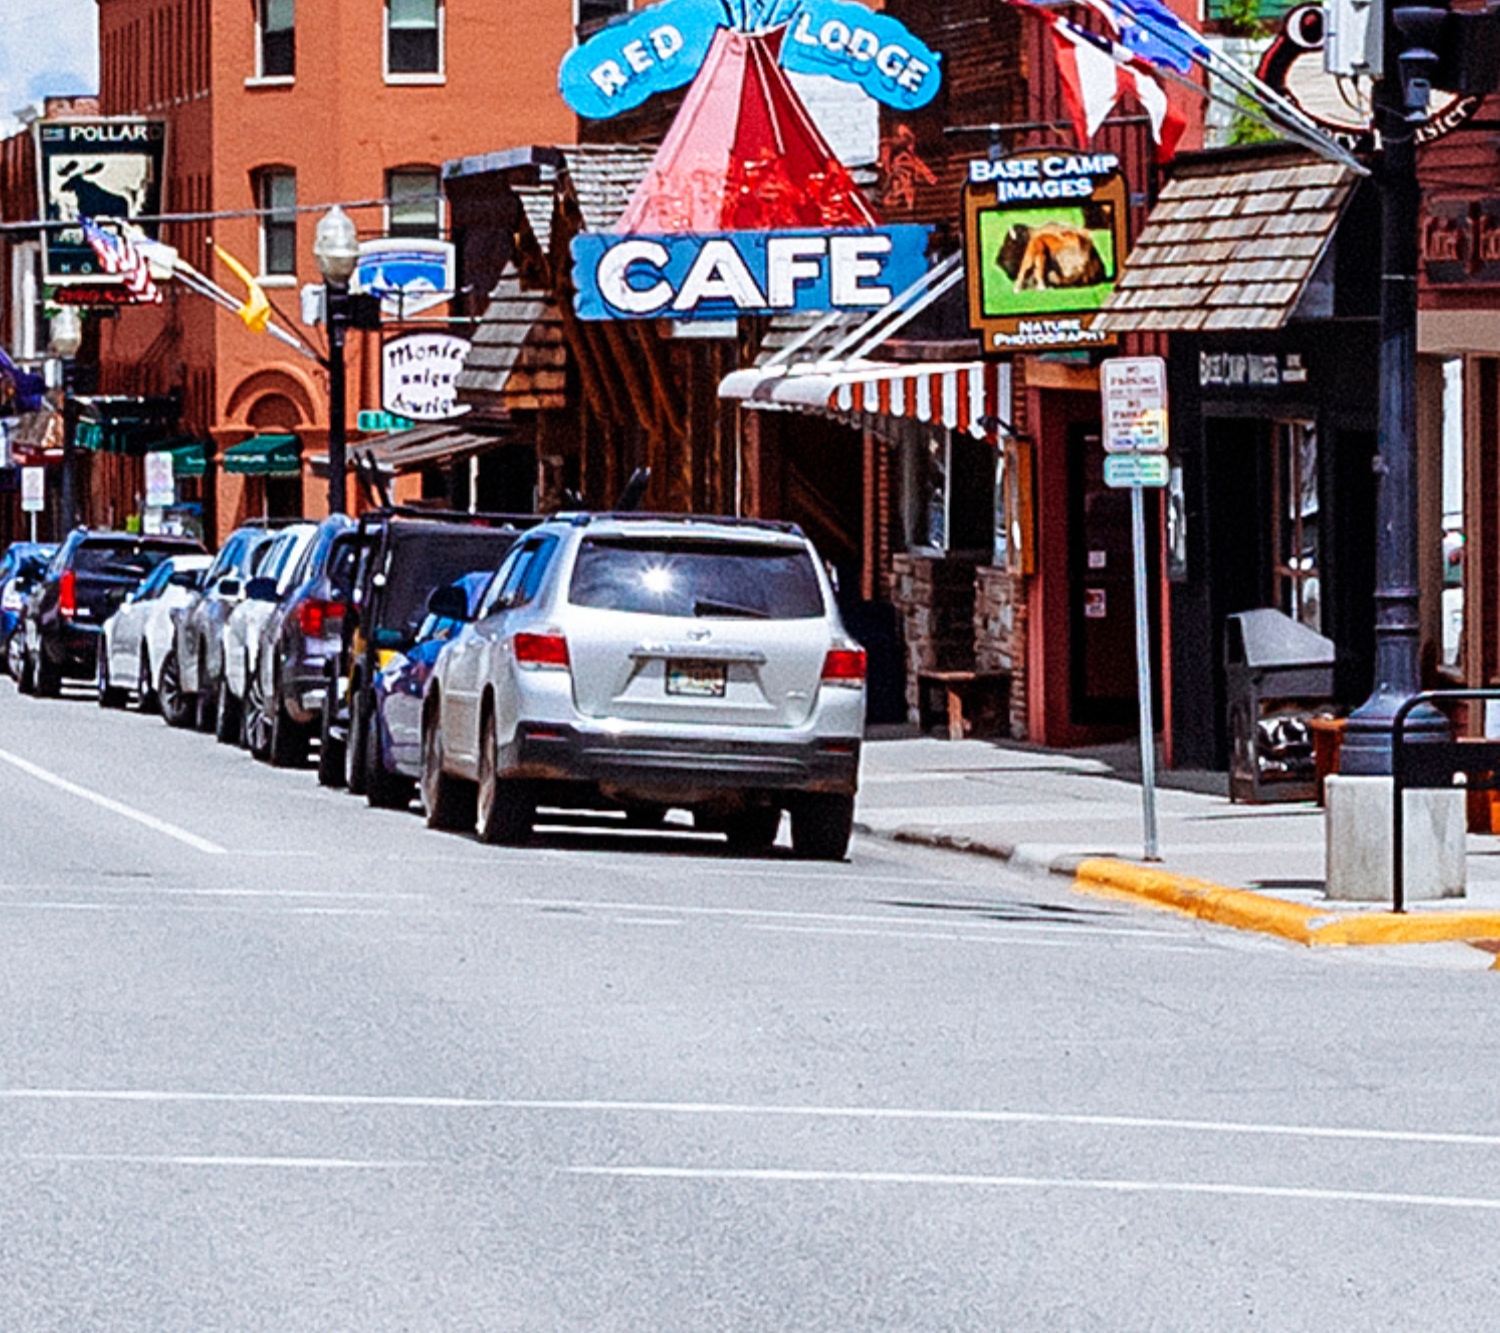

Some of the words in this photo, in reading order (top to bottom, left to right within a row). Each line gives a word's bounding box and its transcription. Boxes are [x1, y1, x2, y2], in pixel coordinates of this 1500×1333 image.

[589, 25, 684, 97] RED
[793, 13, 930, 93] LODGE
[969, 159, 1039, 182] BASE
[1043, 155, 1119, 177] CAMP
[998, 178, 1094, 202] IMAGES
[597, 236, 892, 313] CAFE
[994, 332, 1106, 346] PHOTOGRAPHY
[1019, 320, 1081, 333] NATURE
